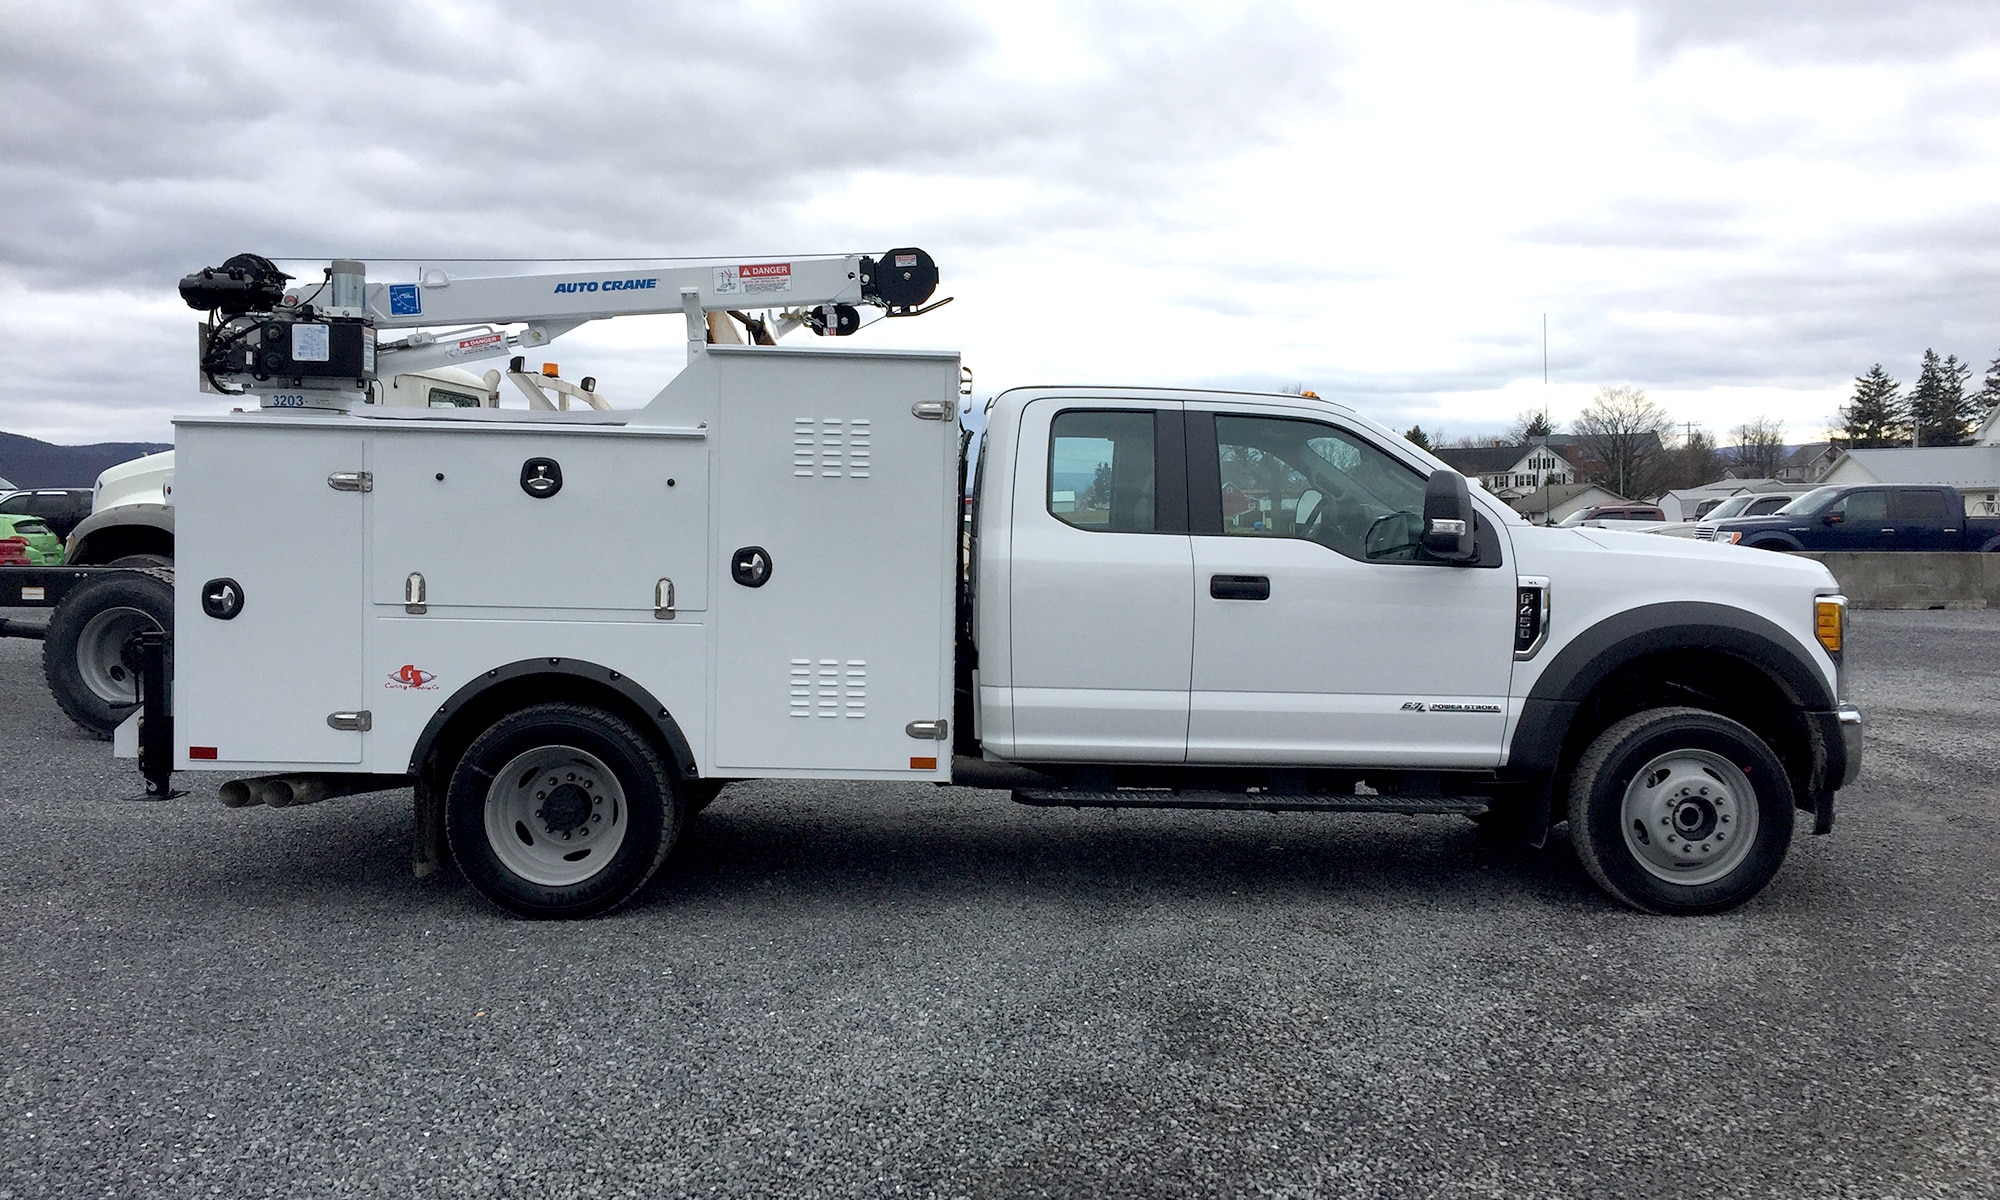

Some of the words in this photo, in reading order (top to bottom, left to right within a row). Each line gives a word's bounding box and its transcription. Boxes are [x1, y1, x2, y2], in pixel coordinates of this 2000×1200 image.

[752, 266, 788, 275] DANGER
[554, 281, 599, 294] AUTO
[601, 278, 657, 292] CRANE
[470, 336, 497, 346] DANGER
[273, 395, 304, 406] 3203
